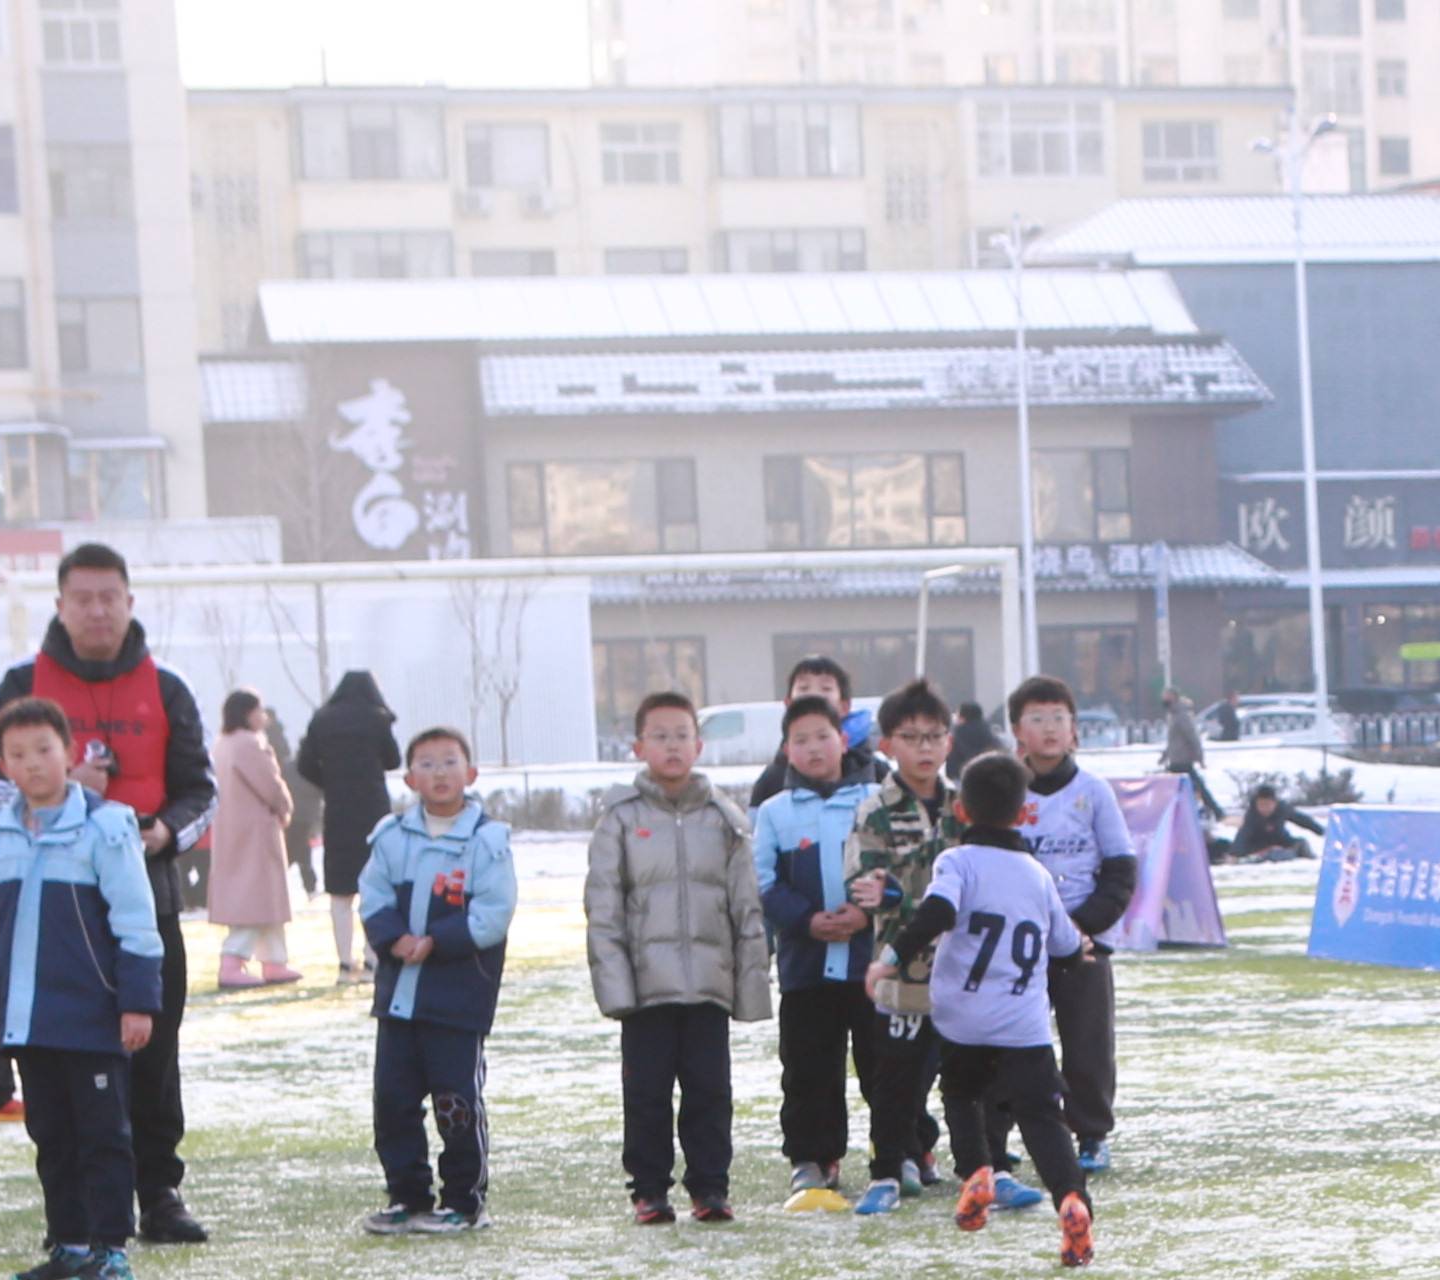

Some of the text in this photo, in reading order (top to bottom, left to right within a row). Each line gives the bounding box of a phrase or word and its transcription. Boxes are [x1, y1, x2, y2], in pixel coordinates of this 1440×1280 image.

[1238, 496, 1397, 552] 欧颜
[963, 911, 1042, 996] 79
[889, 1013, 922, 1040] 59
